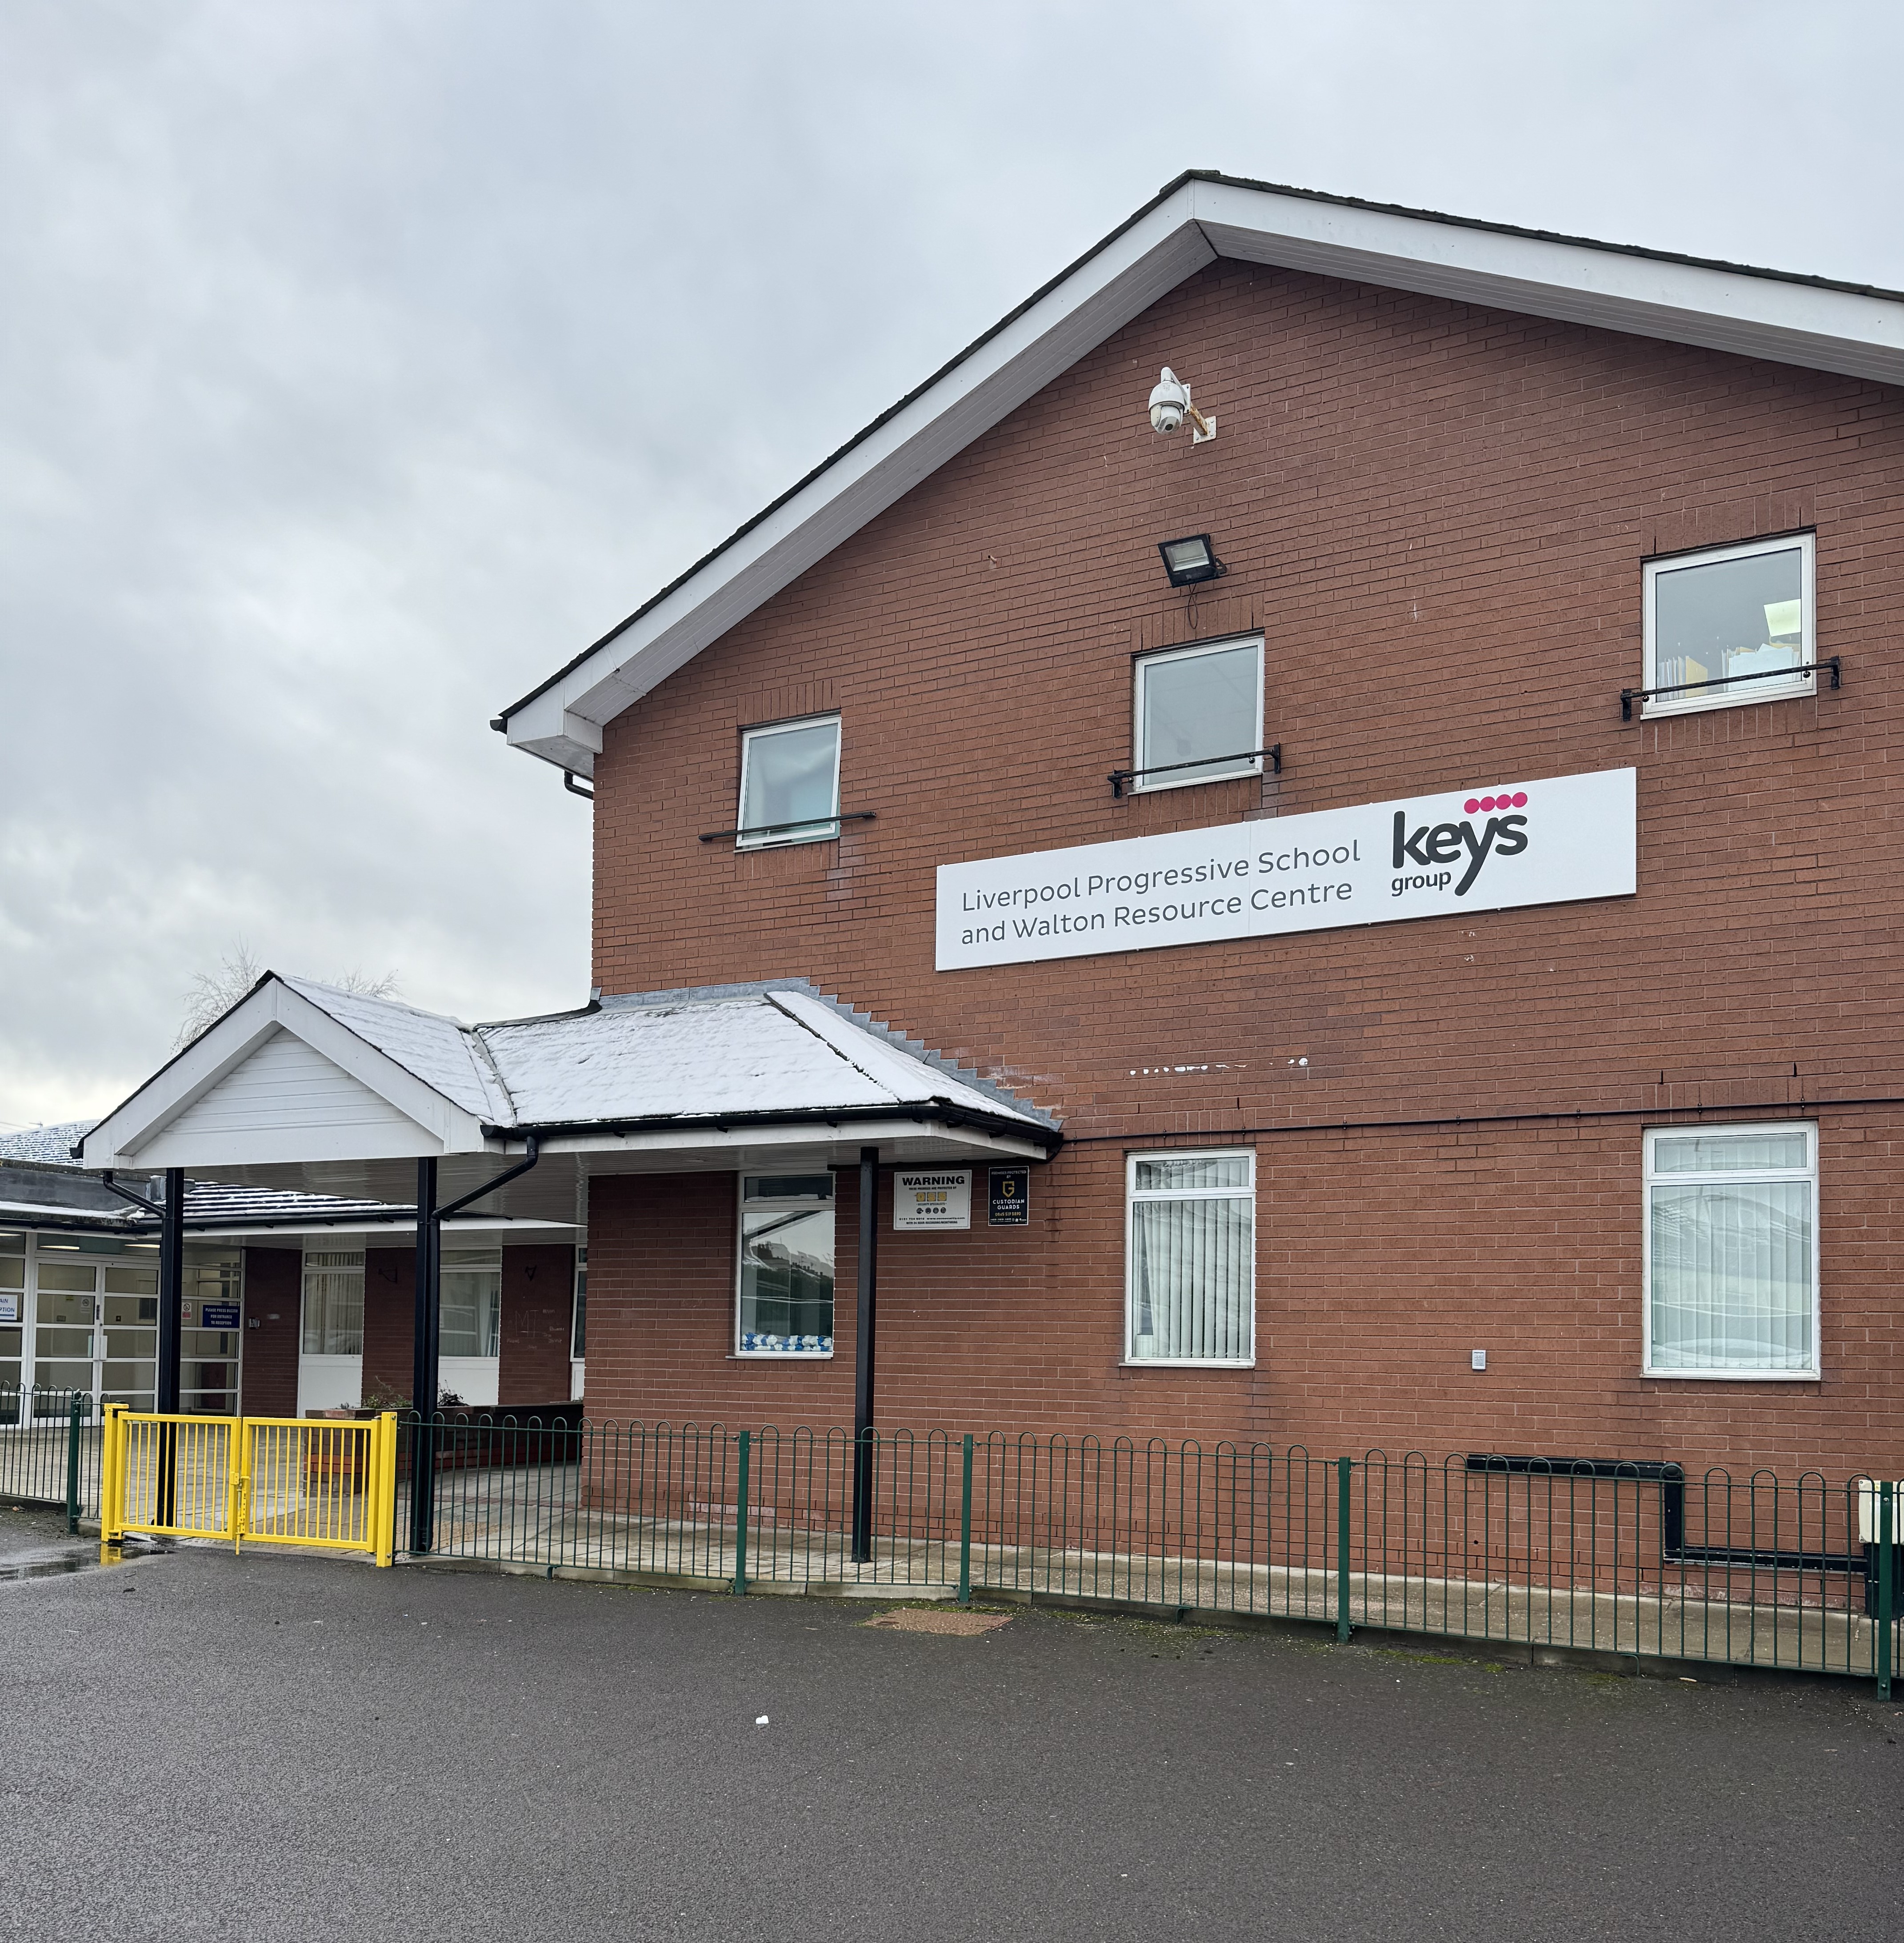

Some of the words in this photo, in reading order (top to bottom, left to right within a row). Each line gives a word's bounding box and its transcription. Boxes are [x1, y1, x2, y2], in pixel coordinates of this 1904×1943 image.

[963, 877, 1080, 911] Liverpool
[1088, 858, 1249, 895] Progressive
[1258, 839, 1360, 873] School
[1392, 811, 1528, 896] keys
[1392, 872, 1451, 897] group
[962, 920, 1005, 945] and
[1012, 913, 1104, 938] Walton
[1115, 897, 1241, 927] Resource
[1251, 882, 1352, 910] Centre
[902, 1176, 964, 1186] WARNING
